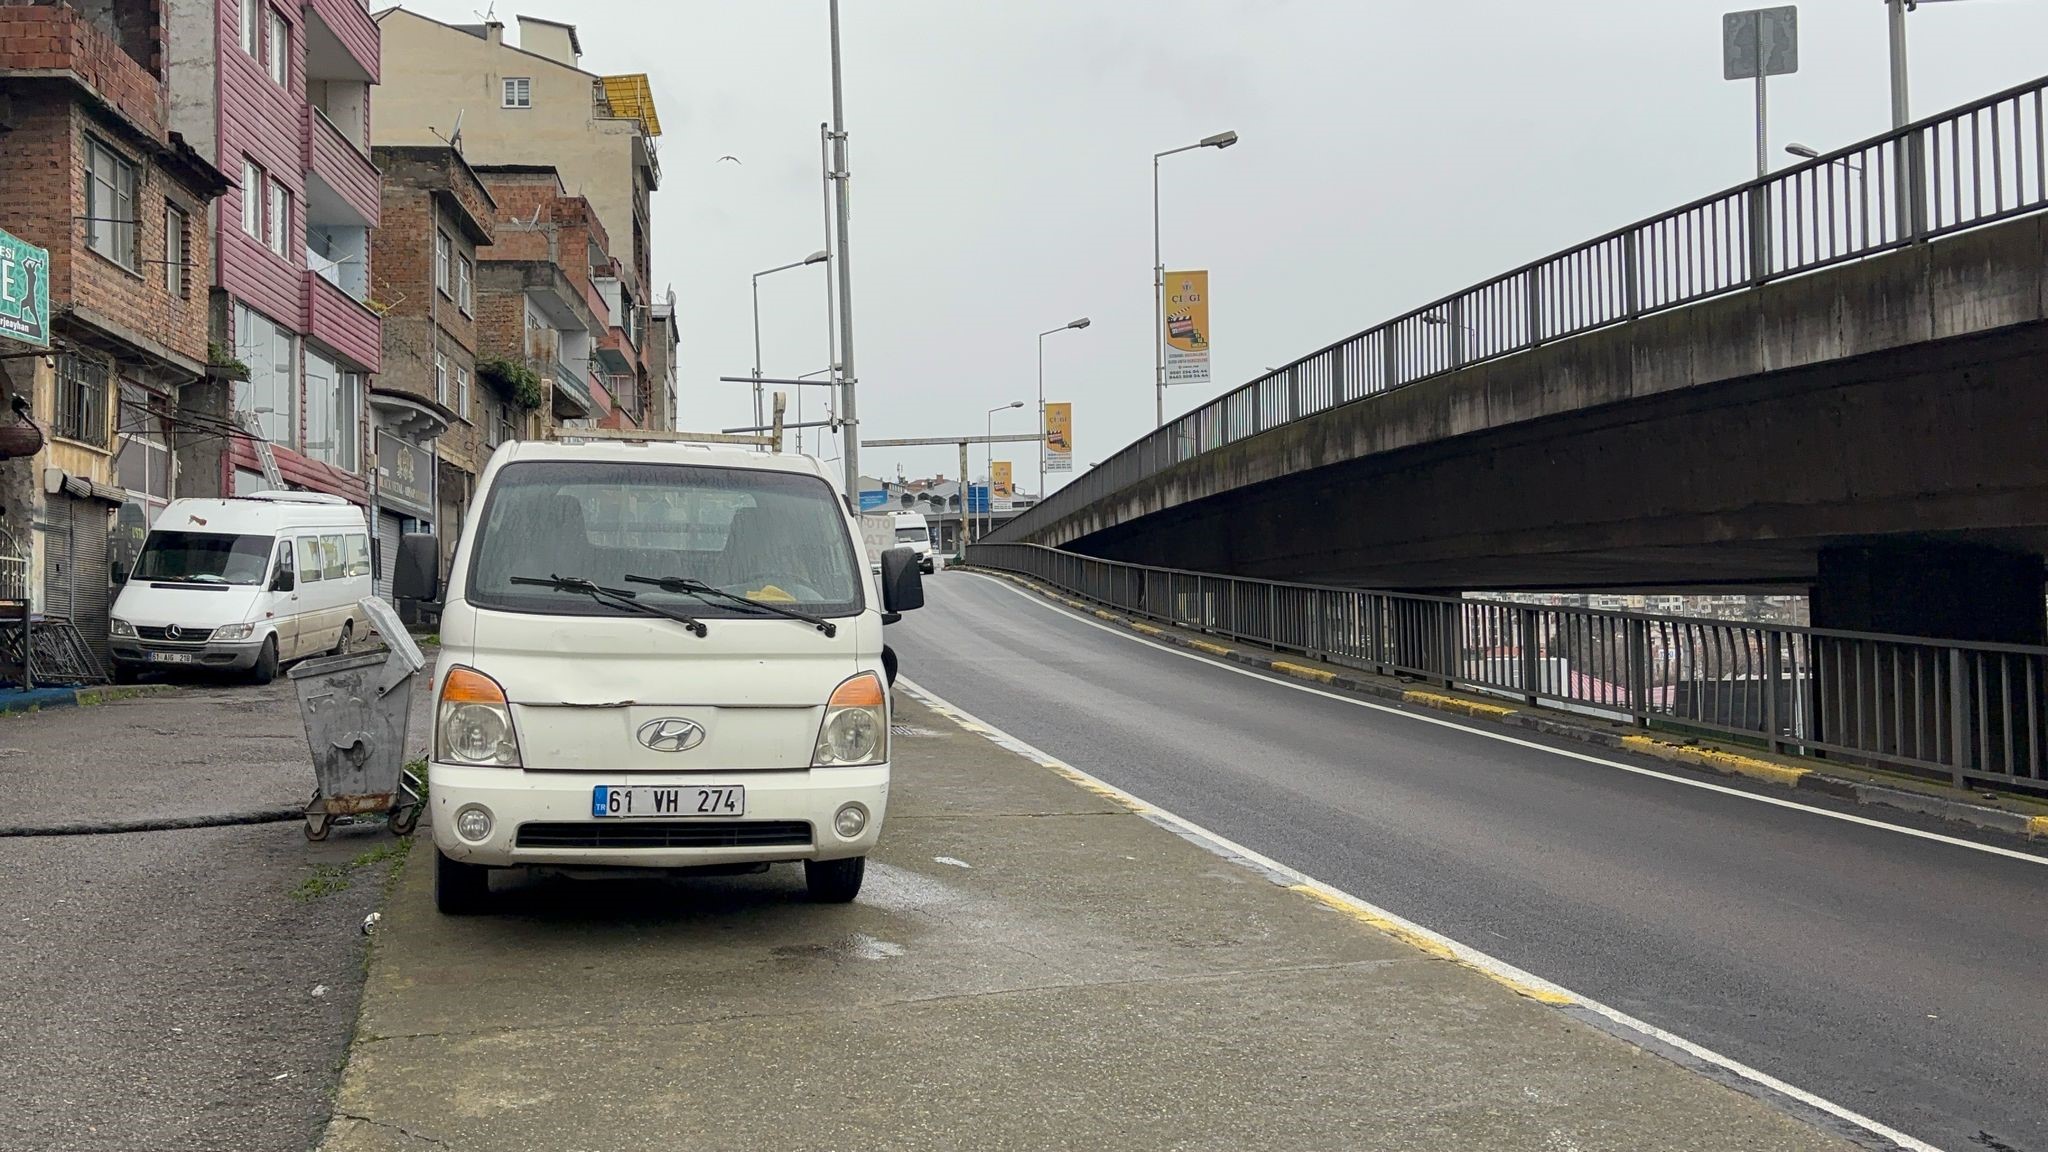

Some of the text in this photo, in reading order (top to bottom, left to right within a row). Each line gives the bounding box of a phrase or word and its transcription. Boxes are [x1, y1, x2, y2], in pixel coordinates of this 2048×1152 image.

[595, 803, 606, 811] TR
[609, 790, 736, 813] 61 VH 274
